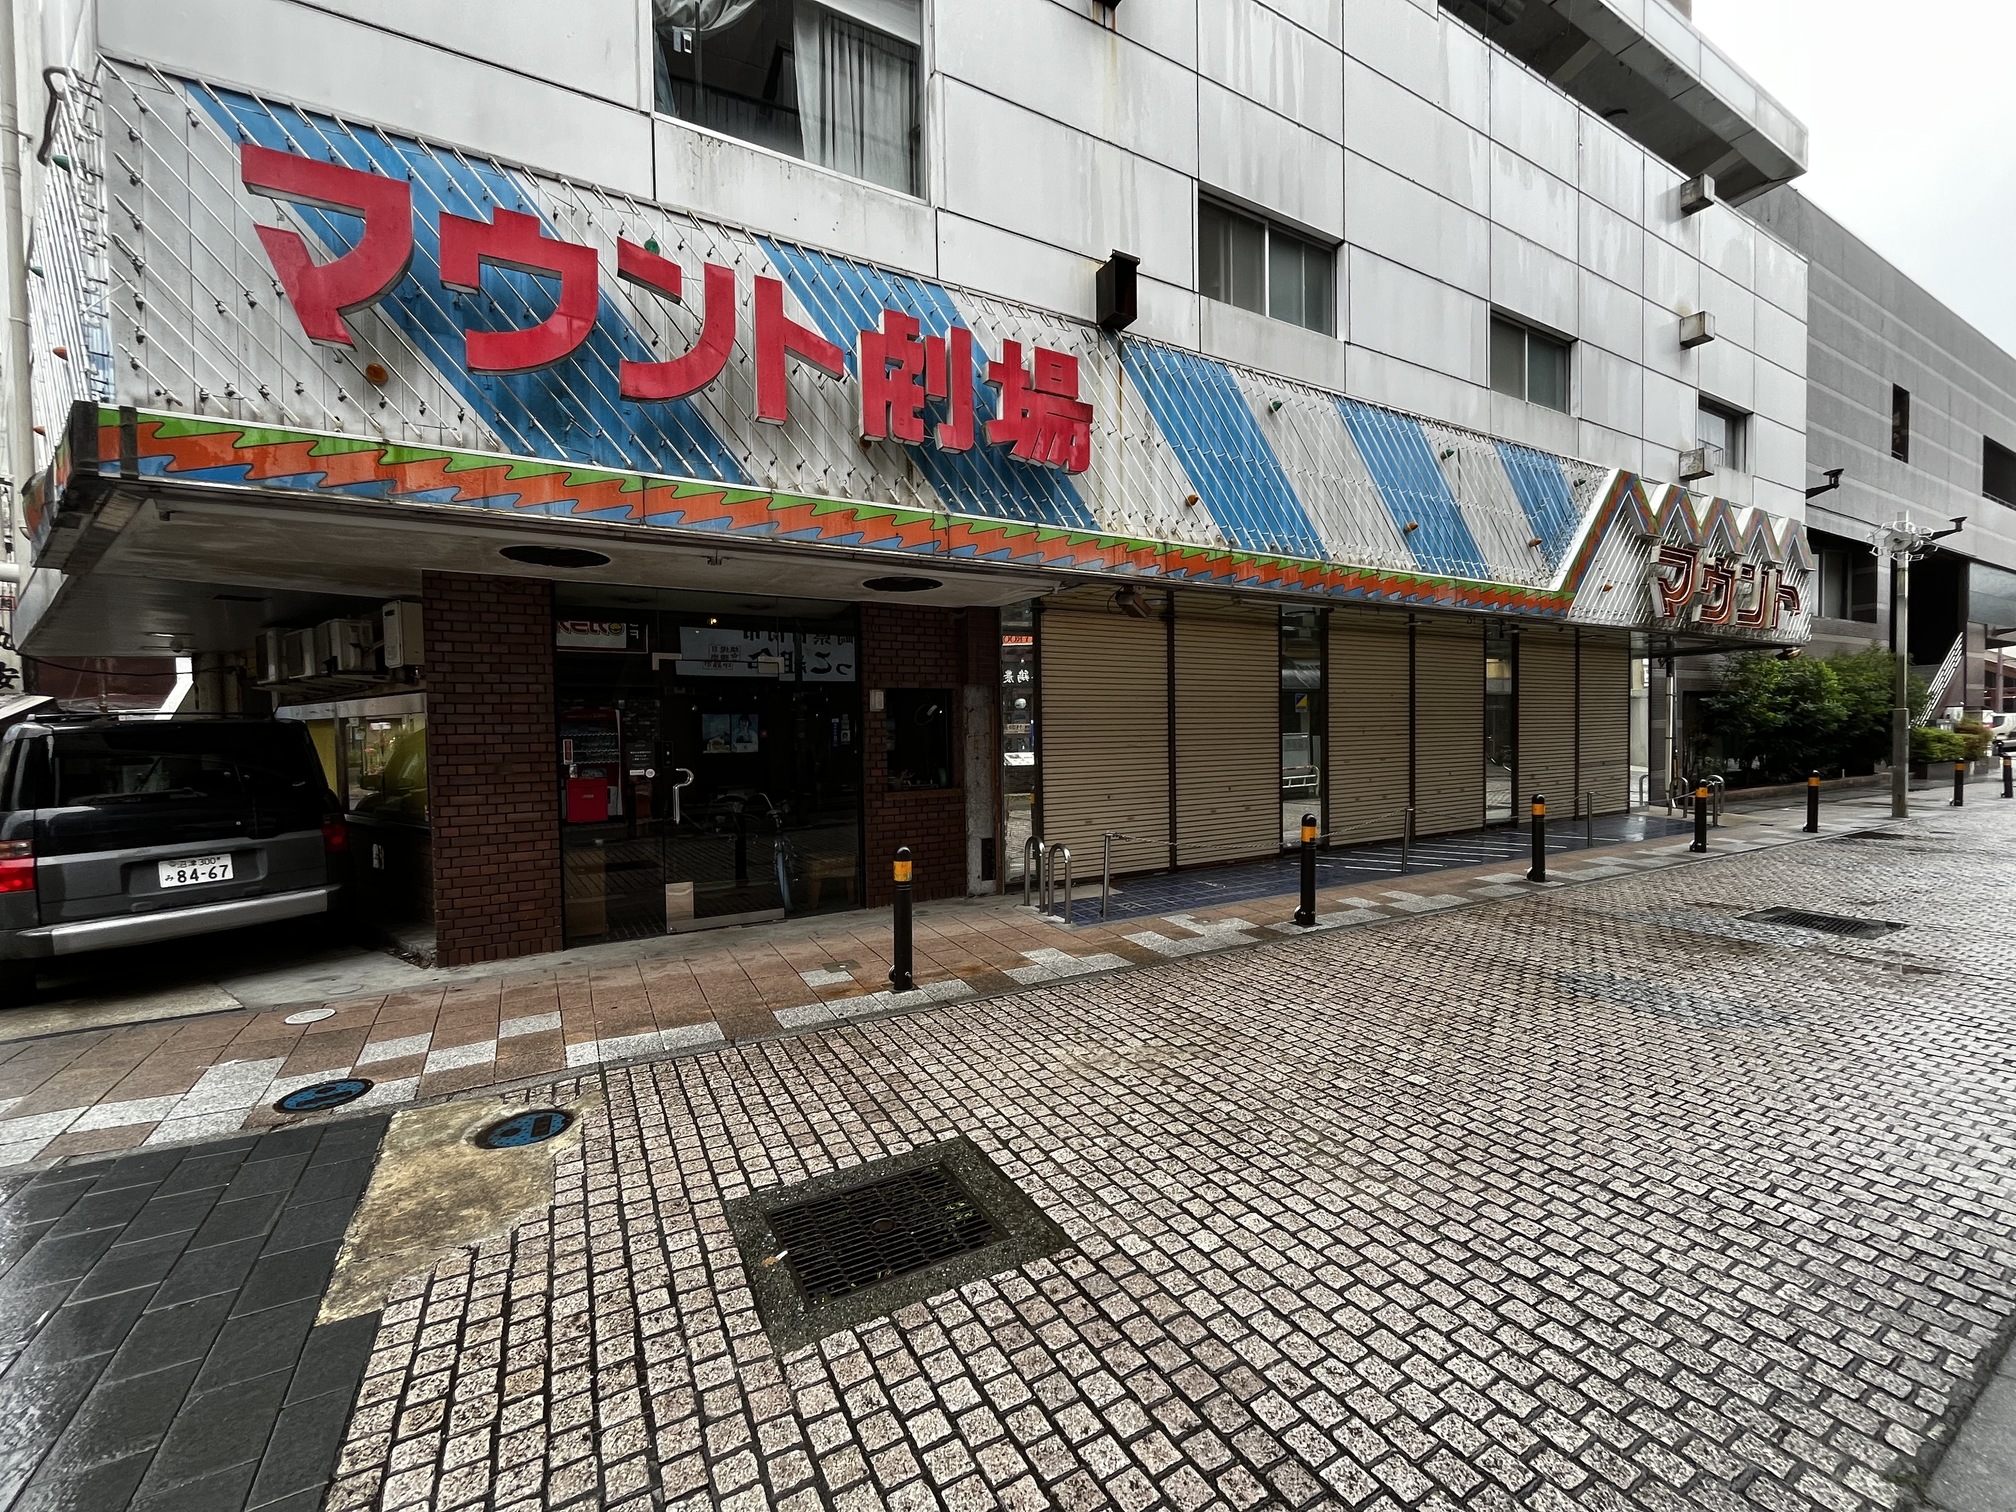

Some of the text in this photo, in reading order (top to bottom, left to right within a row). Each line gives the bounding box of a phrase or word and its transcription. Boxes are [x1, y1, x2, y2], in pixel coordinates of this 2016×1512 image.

[241, 143, 1094, 474] マウント劇場
[1652, 545, 1801, 630] マウント
[177, 864, 229, 883] 84-67
[198, 857, 217, 866] 300
